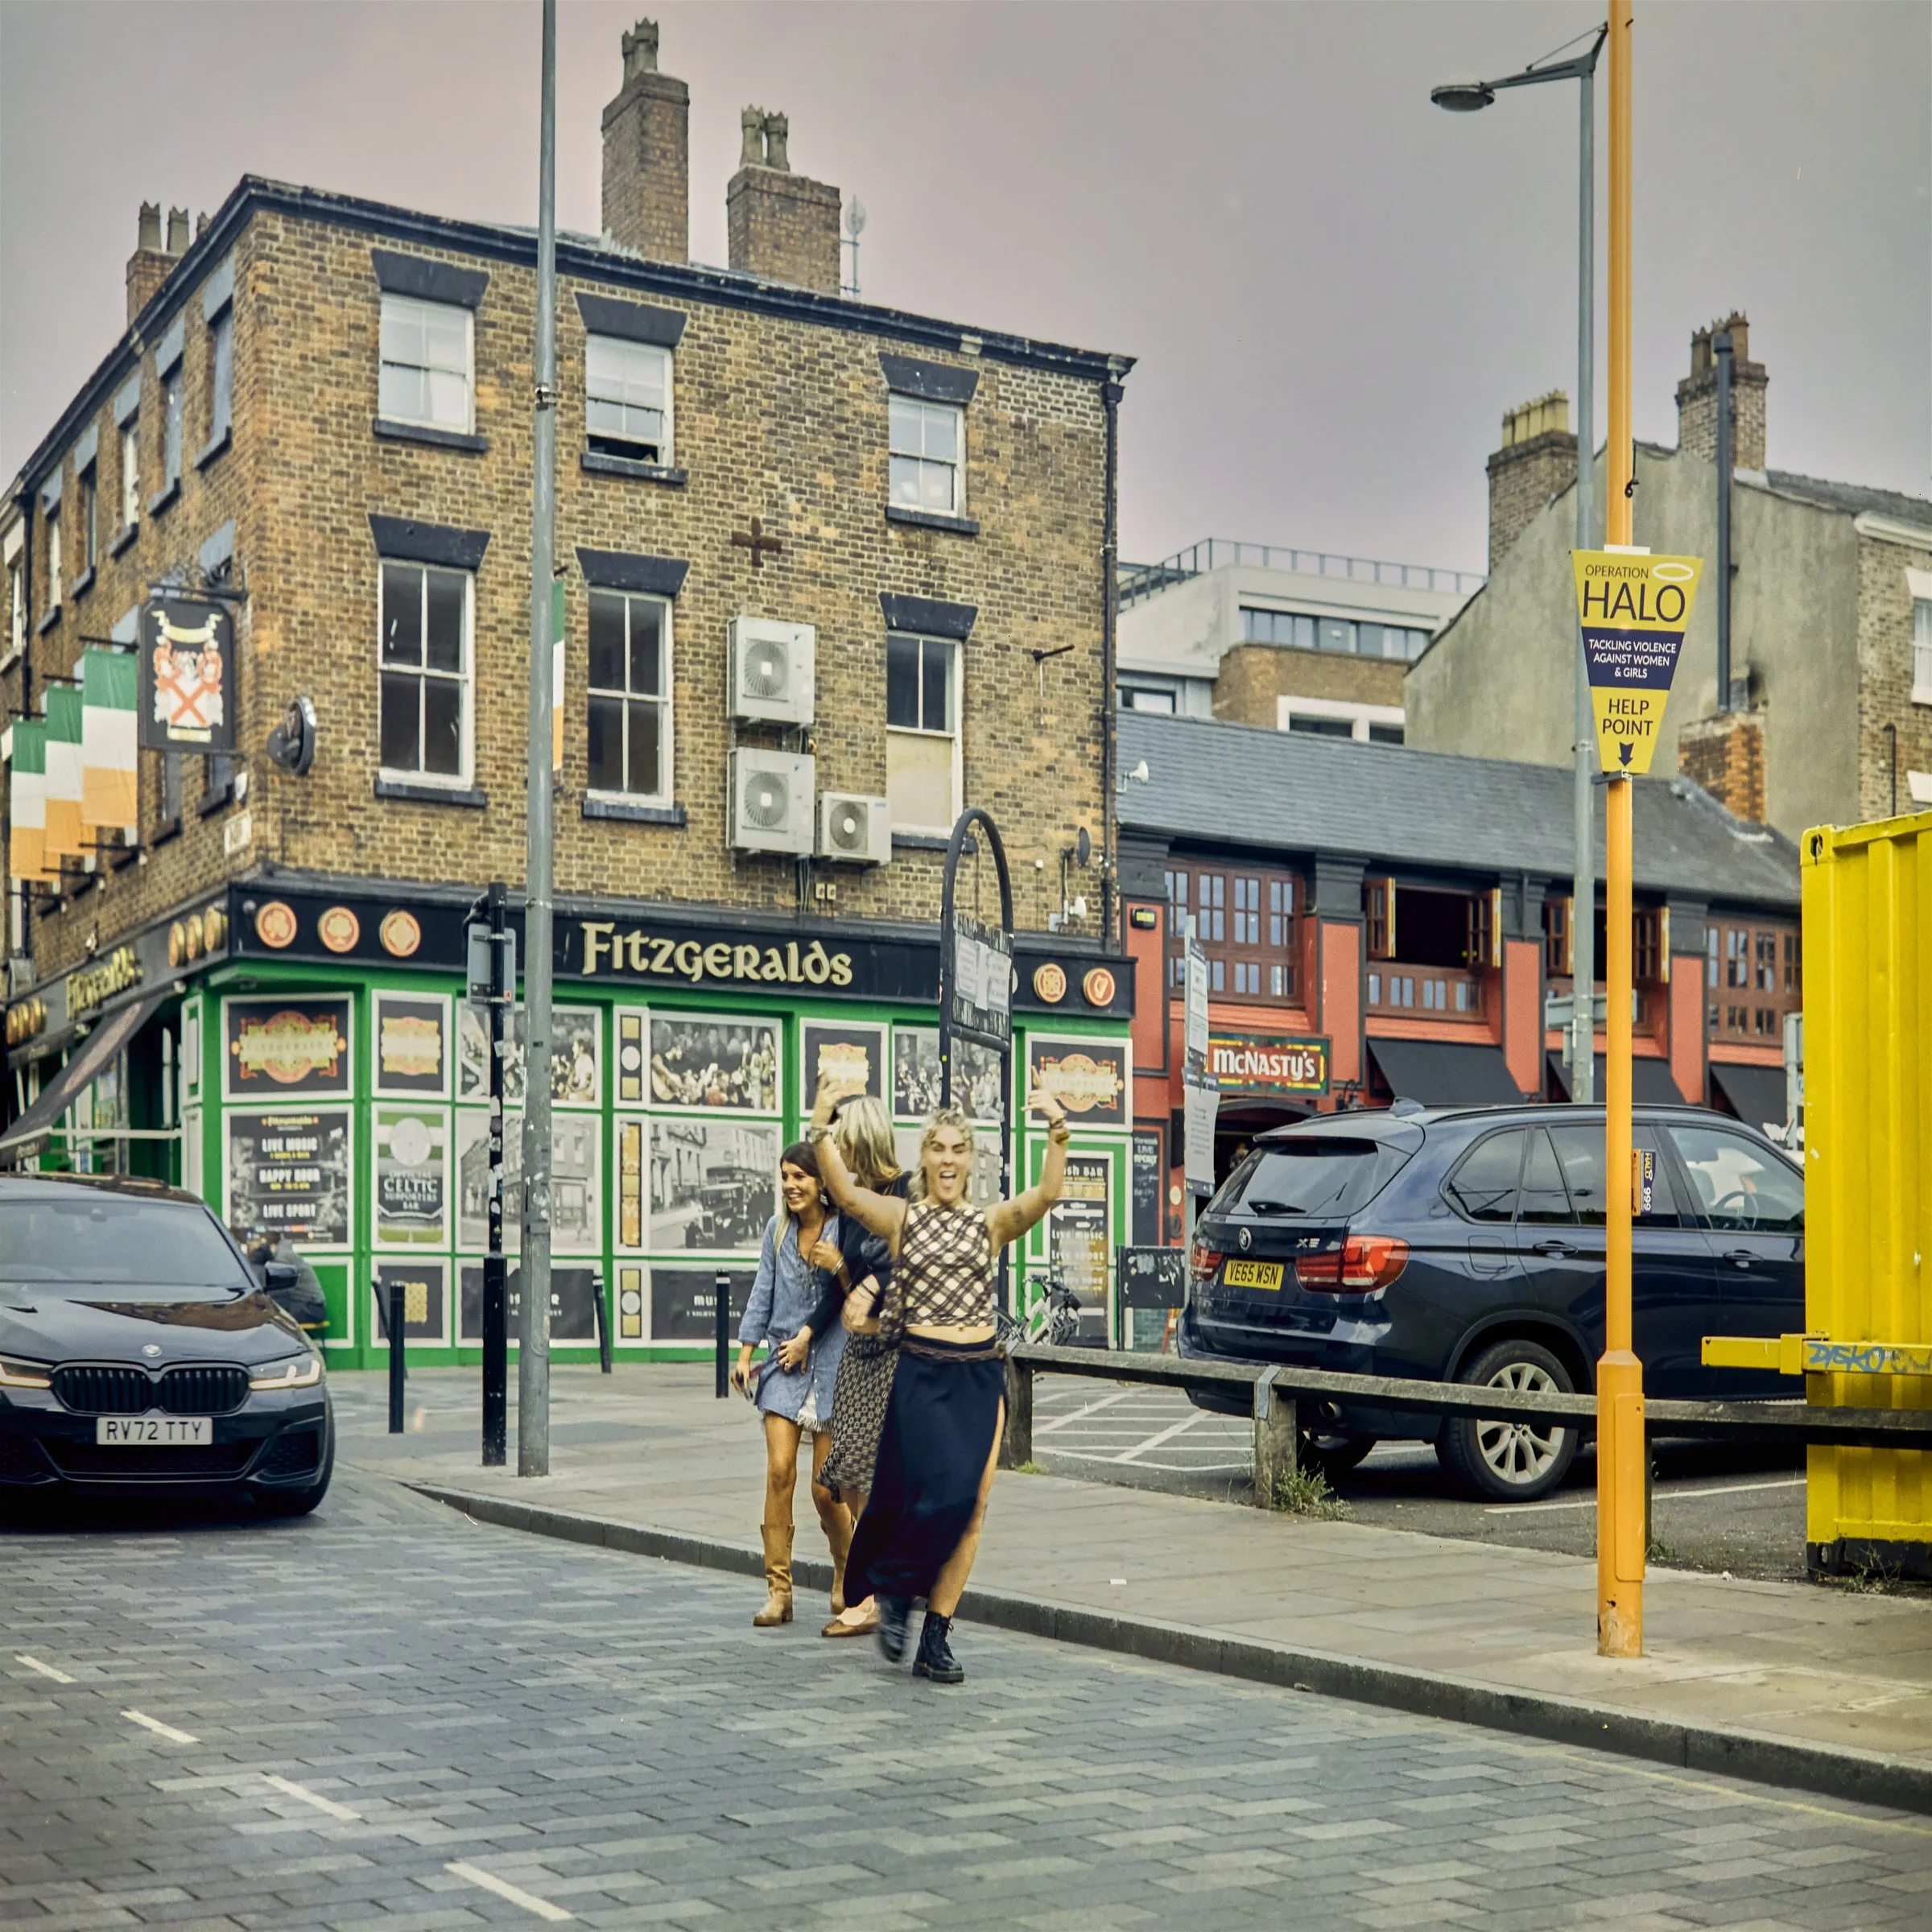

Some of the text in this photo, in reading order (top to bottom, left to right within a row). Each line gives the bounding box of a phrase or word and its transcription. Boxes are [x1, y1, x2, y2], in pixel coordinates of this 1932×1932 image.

[1585, 564, 1649, 579] OPERATION
[1583, 580, 1686, 623] HALO
[1588, 639, 1677, 654] TACKLING VIOLENCE
[1593, 653, 1670, 667] AGAINST WOMEN
[1614, 667, 1648, 679] & GIRLS
[1608, 698, 1649, 716] HELP
[1602, 719, 1653, 736] POINT
[383, 1178, 438, 1193] CELTIC
[1644, 1187, 1652, 1212] 999
[1229, 1262, 1279, 1285] VE65 WSN
[106, 1421, 201, 1440] RV72 TTY
